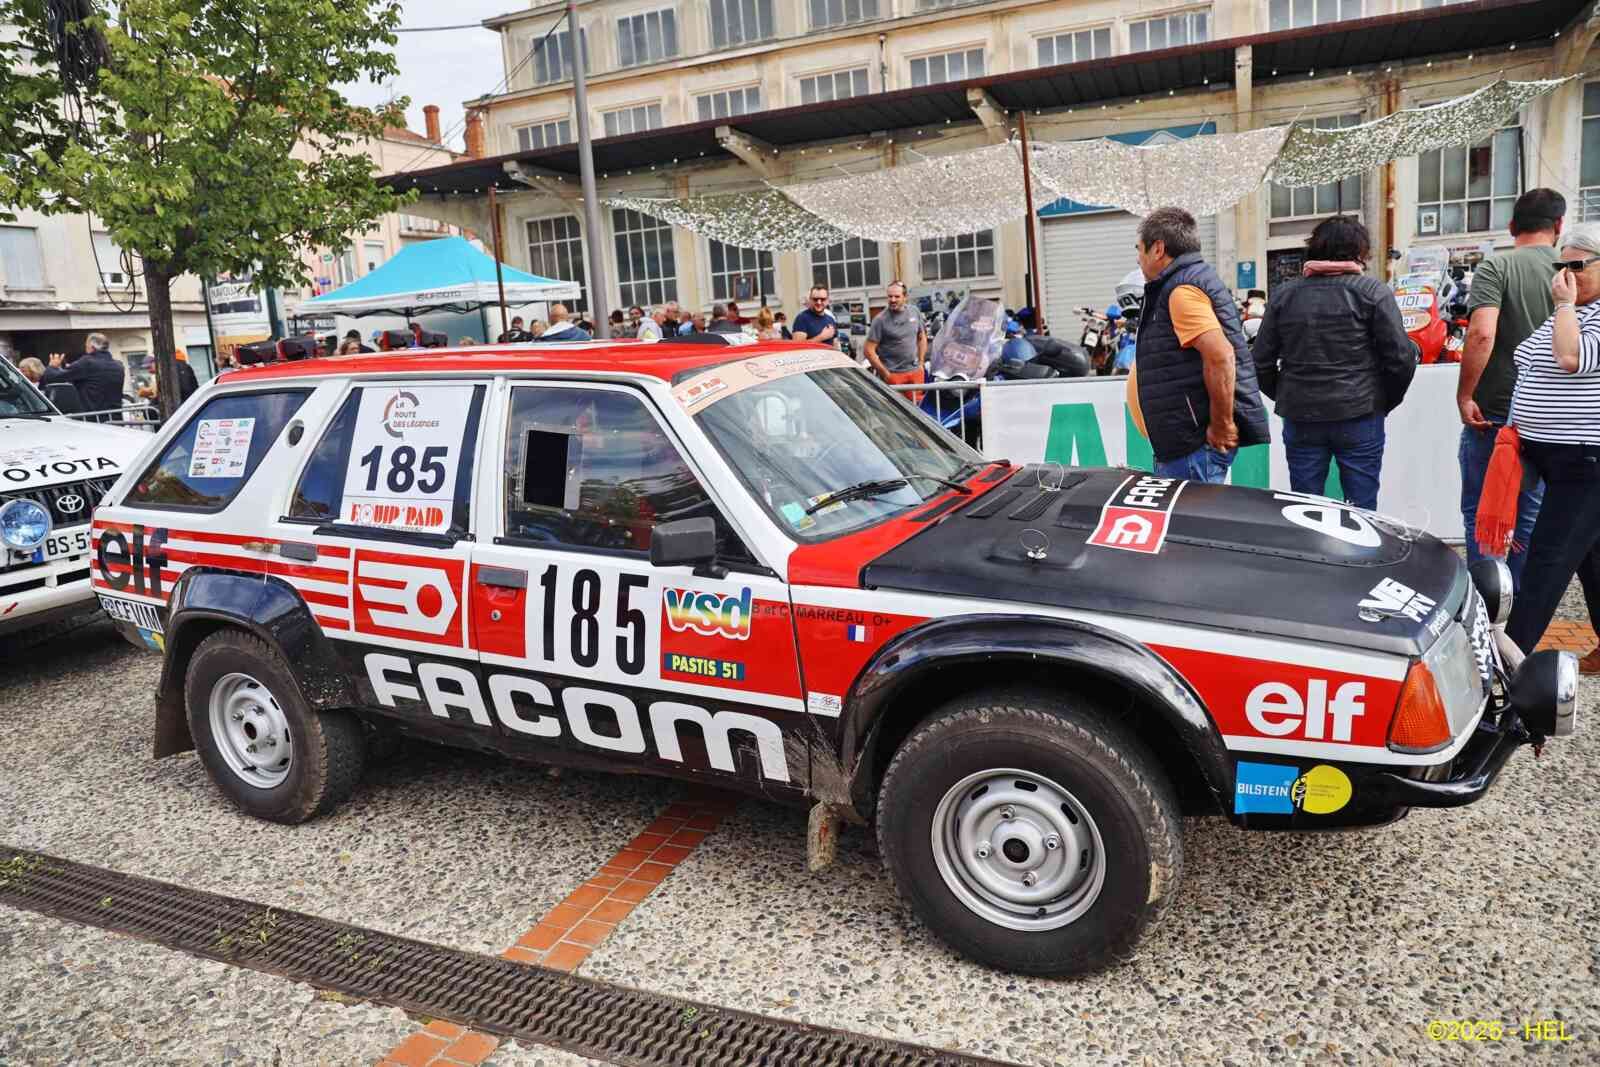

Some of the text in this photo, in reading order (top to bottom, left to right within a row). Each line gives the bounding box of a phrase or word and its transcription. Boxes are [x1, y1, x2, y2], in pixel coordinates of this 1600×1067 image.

[360, 445, 449, 494] 185
[98, 524, 169, 599] elf
[540, 564, 650, 676] 185
[664, 586, 753, 640] vsd
[796, 606, 865, 625] MARREAU
[672, 655, 738, 680] PASTIS 51
[363, 652, 791, 783] FACOM
[1245, 678, 1367, 742] elf
[1237, 782, 1288, 797] BILSTEIN
